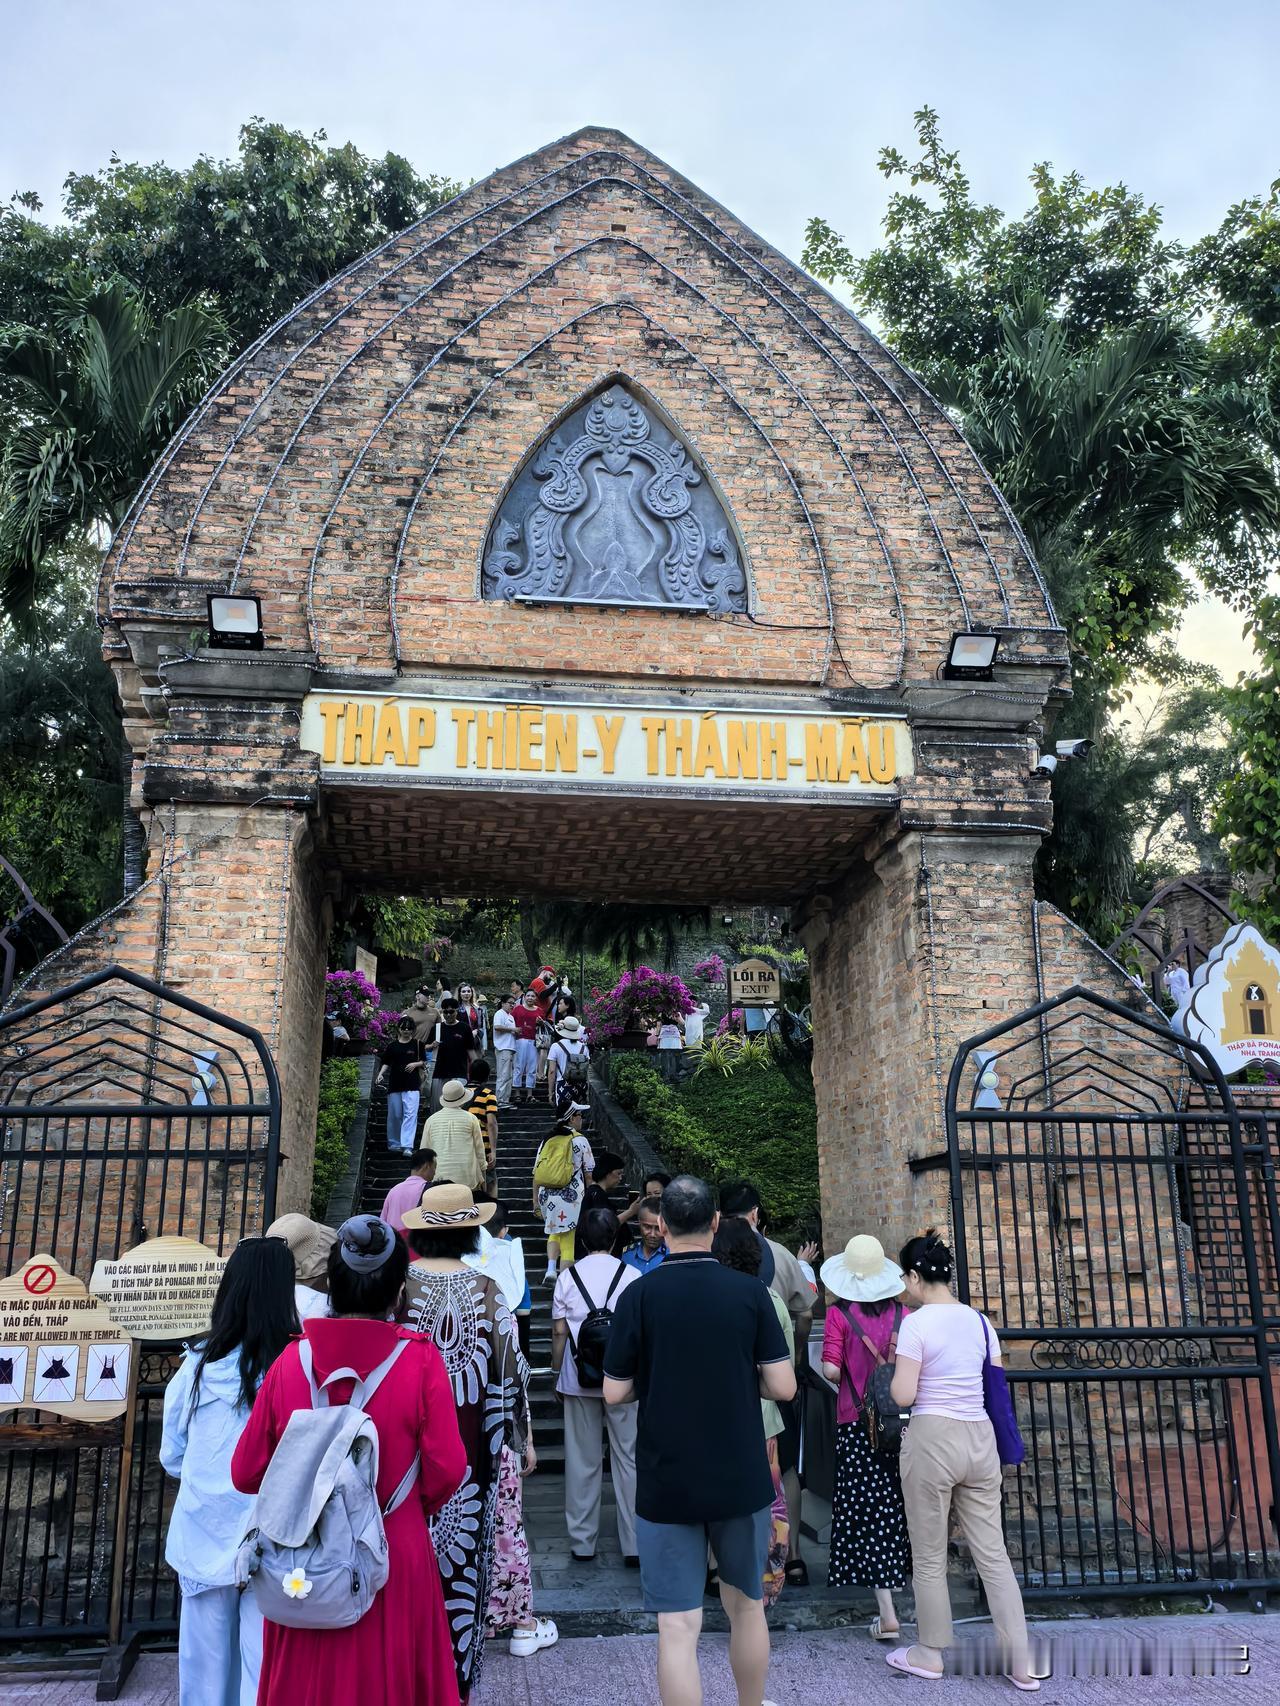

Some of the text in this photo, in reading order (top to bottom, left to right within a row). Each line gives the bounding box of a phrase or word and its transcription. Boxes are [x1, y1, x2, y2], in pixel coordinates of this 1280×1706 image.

[319, 697, 436, 766] THÁP
[758, 971, 776, 982] RA
[741, 984, 770, 994] EXIT
[1227, 1041, 1246, 1052] THÁP
[1258, 1041, 1280, 1050] PONA
[199, 1263, 203, 1272] 1
[164, 1276, 195, 1287] PONAGAR
[3, 1314, 21, 1327] VÀO
[46, 1314, 69, 1327] THÁP
[4, 1331, 18, 1341] ARE
[19, 1331, 34, 1341] NOT
[35, 1331, 69, 1341] ALLOWED
[70, 1331, 78, 1341] IN
[79, 1330, 93, 1340] THE
[94, 1330, 121, 1340] TEMPLE
